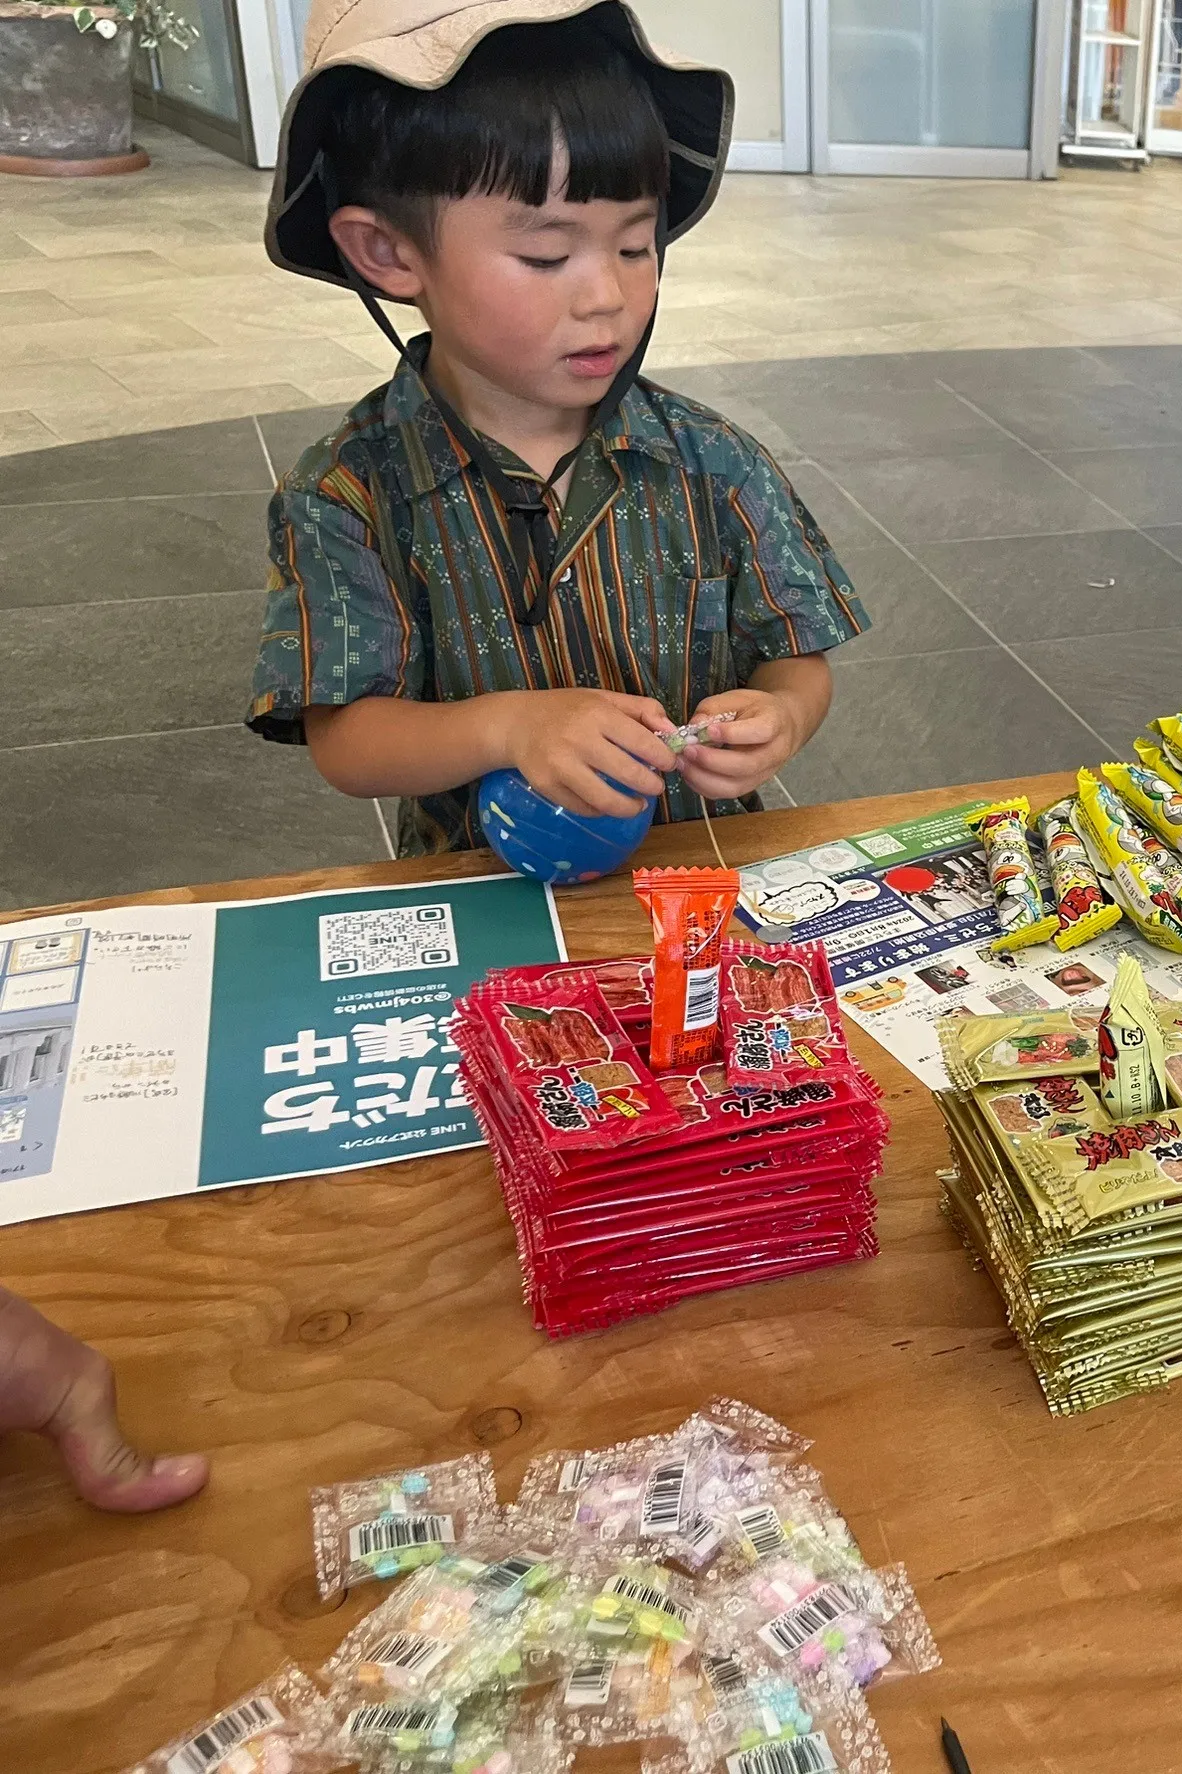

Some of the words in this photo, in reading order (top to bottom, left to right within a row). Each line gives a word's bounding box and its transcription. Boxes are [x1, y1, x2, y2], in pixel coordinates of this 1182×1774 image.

[368, 934, 409, 946] LINE
[333, 991, 453, 1015] @304jmwbs
[339, 1128, 429, 1150] 公式アカウント
[430, 1121, 467, 1136] LINE
[1076, 1119, 1181, 1171] 焼肉さん
